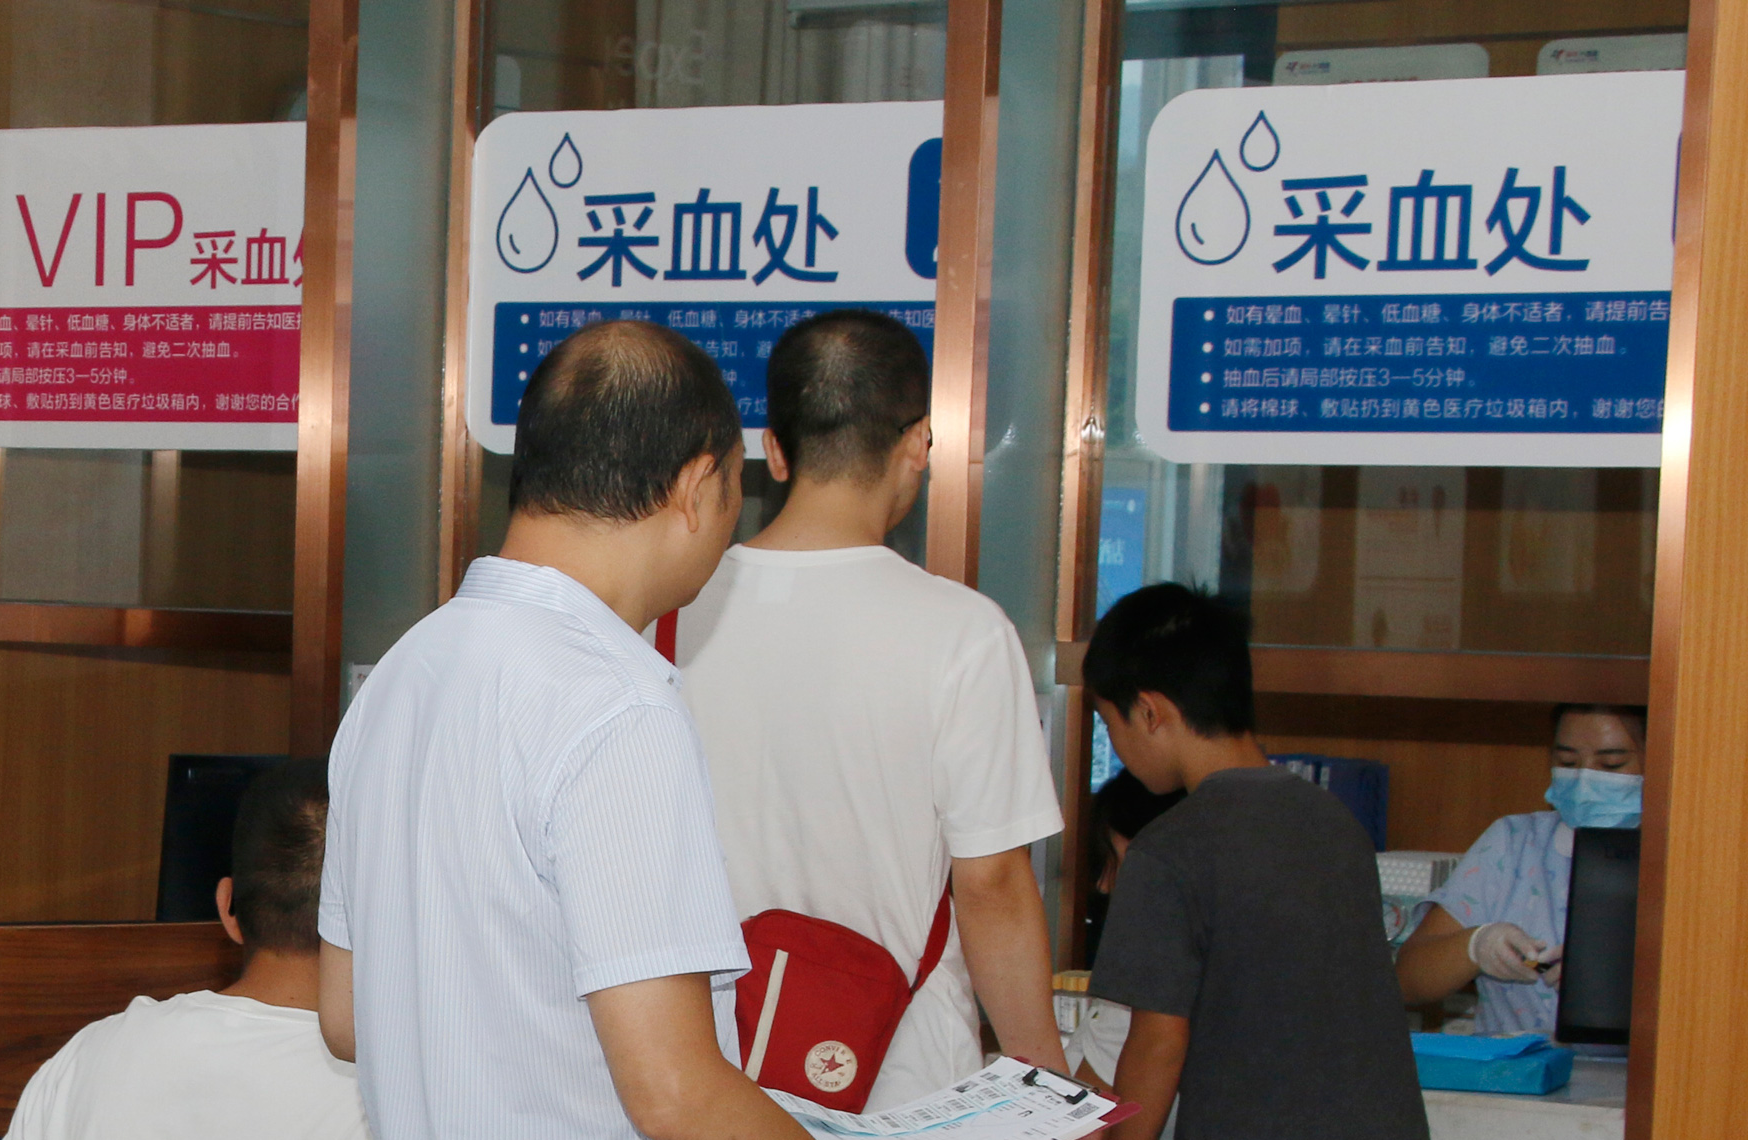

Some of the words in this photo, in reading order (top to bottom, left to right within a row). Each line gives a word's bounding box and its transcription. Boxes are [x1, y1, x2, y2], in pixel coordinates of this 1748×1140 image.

[16, 191, 184, 287] VIP
[189, 227, 303, 290] 采血
[575, 186, 840, 287] 采血处
[1271, 165, 1591, 280] 采血处
